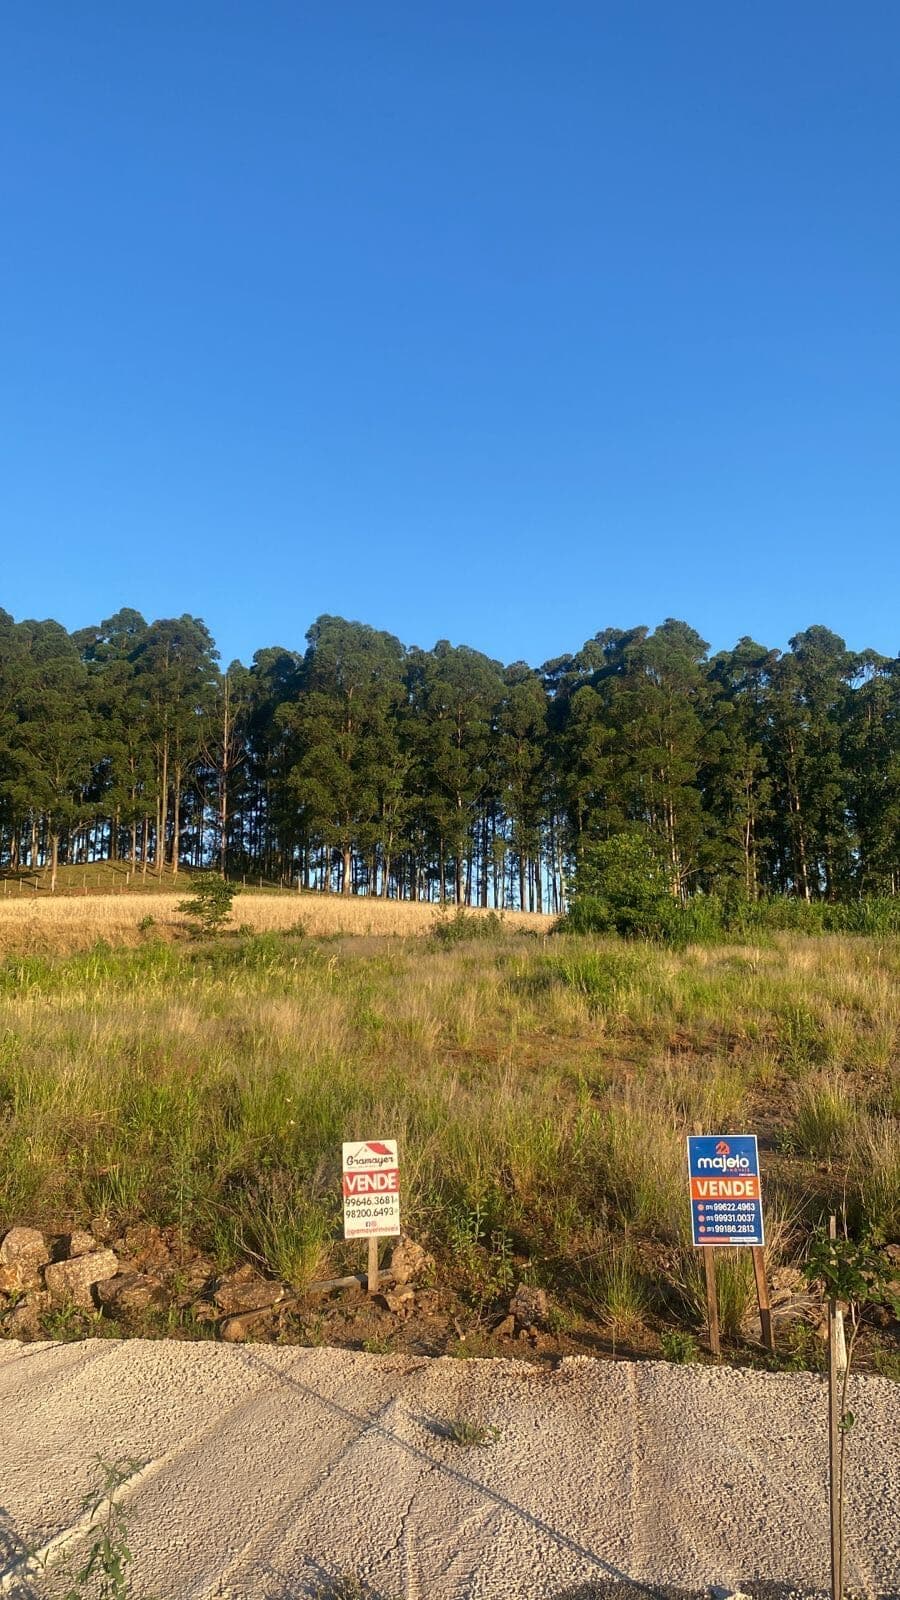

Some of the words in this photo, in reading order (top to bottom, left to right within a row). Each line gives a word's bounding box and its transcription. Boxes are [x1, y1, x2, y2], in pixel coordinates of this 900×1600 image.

[346, 1155, 394, 1167] Gramayer
[345, 1172, 397, 1193] VENDE
[696, 1181, 755, 1197] VENDE
[345, 1195, 394, 1207] 99646.3681
[345, 1207, 394, 1218] 98200.6493
